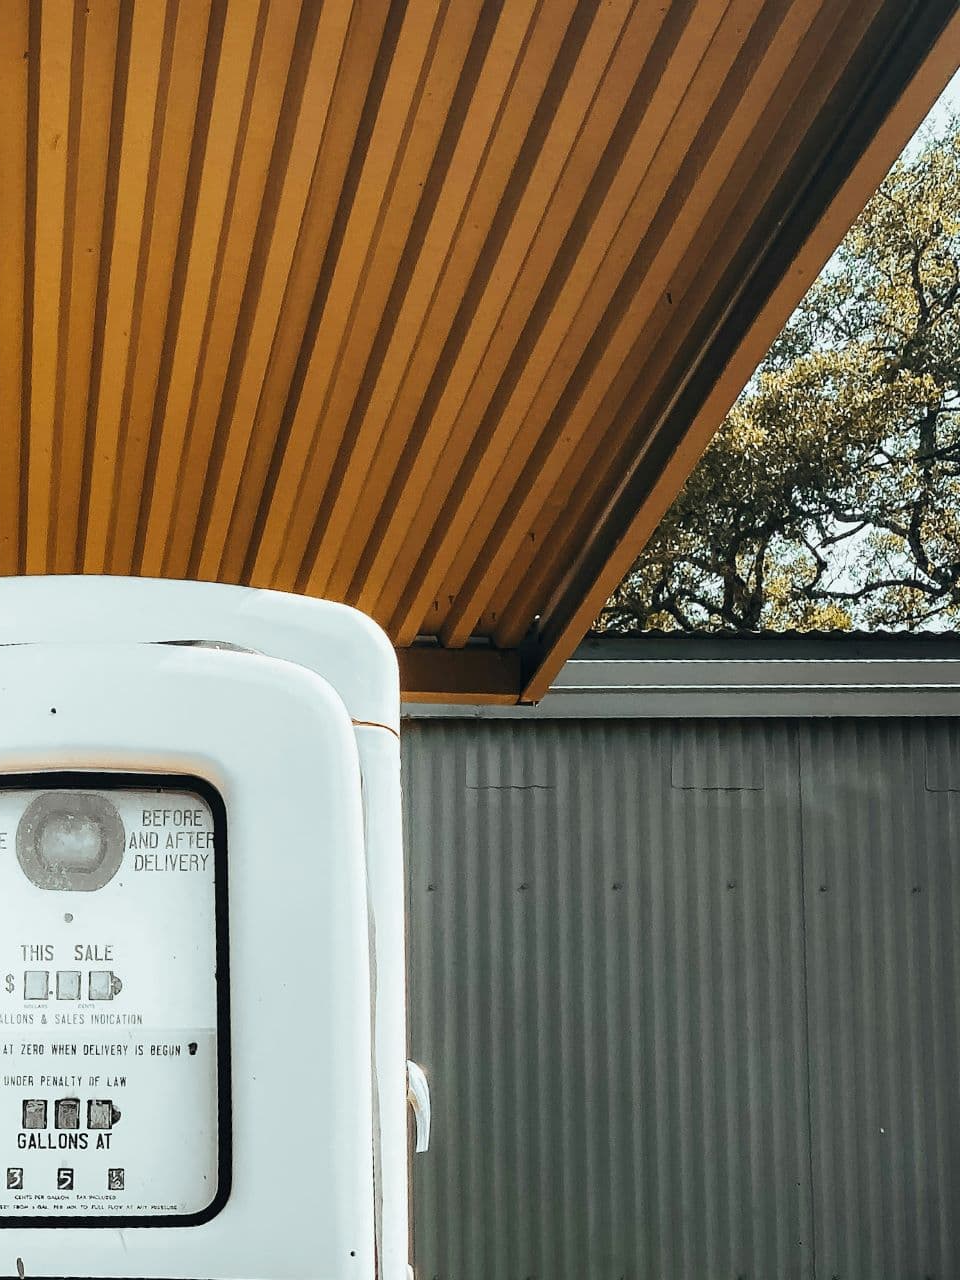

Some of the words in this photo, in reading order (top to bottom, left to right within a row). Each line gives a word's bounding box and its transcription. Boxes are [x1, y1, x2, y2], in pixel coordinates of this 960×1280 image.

[142, 809, 203, 826] BEFORE
[129, 831, 158, 849] AND
[165, 831, 215, 849] AFTER
[134, 854, 209, 872] DELIVERY
[20, 944, 55, 961] THIS
[74, 944, 114, 961] SALE
[5, 973, 15, 994] $
[40, 1013, 48, 1025] &
[54, 1013, 85, 1025] SALES
[91, 1013, 144, 1025] INDICATION
[3, 1044, 14, 1056] AT
[21, 1044, 45, 1056] ZERO
[51, 1044, 77, 1056] WHEN
[83, 1044, 128, 1056] DELIVERY
[135, 1044, 144, 1056] IS
[150, 1044, 181, 1056] BEGUN
[4, 1075, 34, 1087] UNDER
[40, 1075, 82, 1087] PENALTY
[89, 1075, 100, 1087] OF
[107, 1075, 127, 1087] LAW
[17, 1132, 89, 1149] GALLONS
[96, 1132, 113, 1149] AT
[8, 1168, 22, 1188] 3
[58, 1169, 72, 1189] 5
